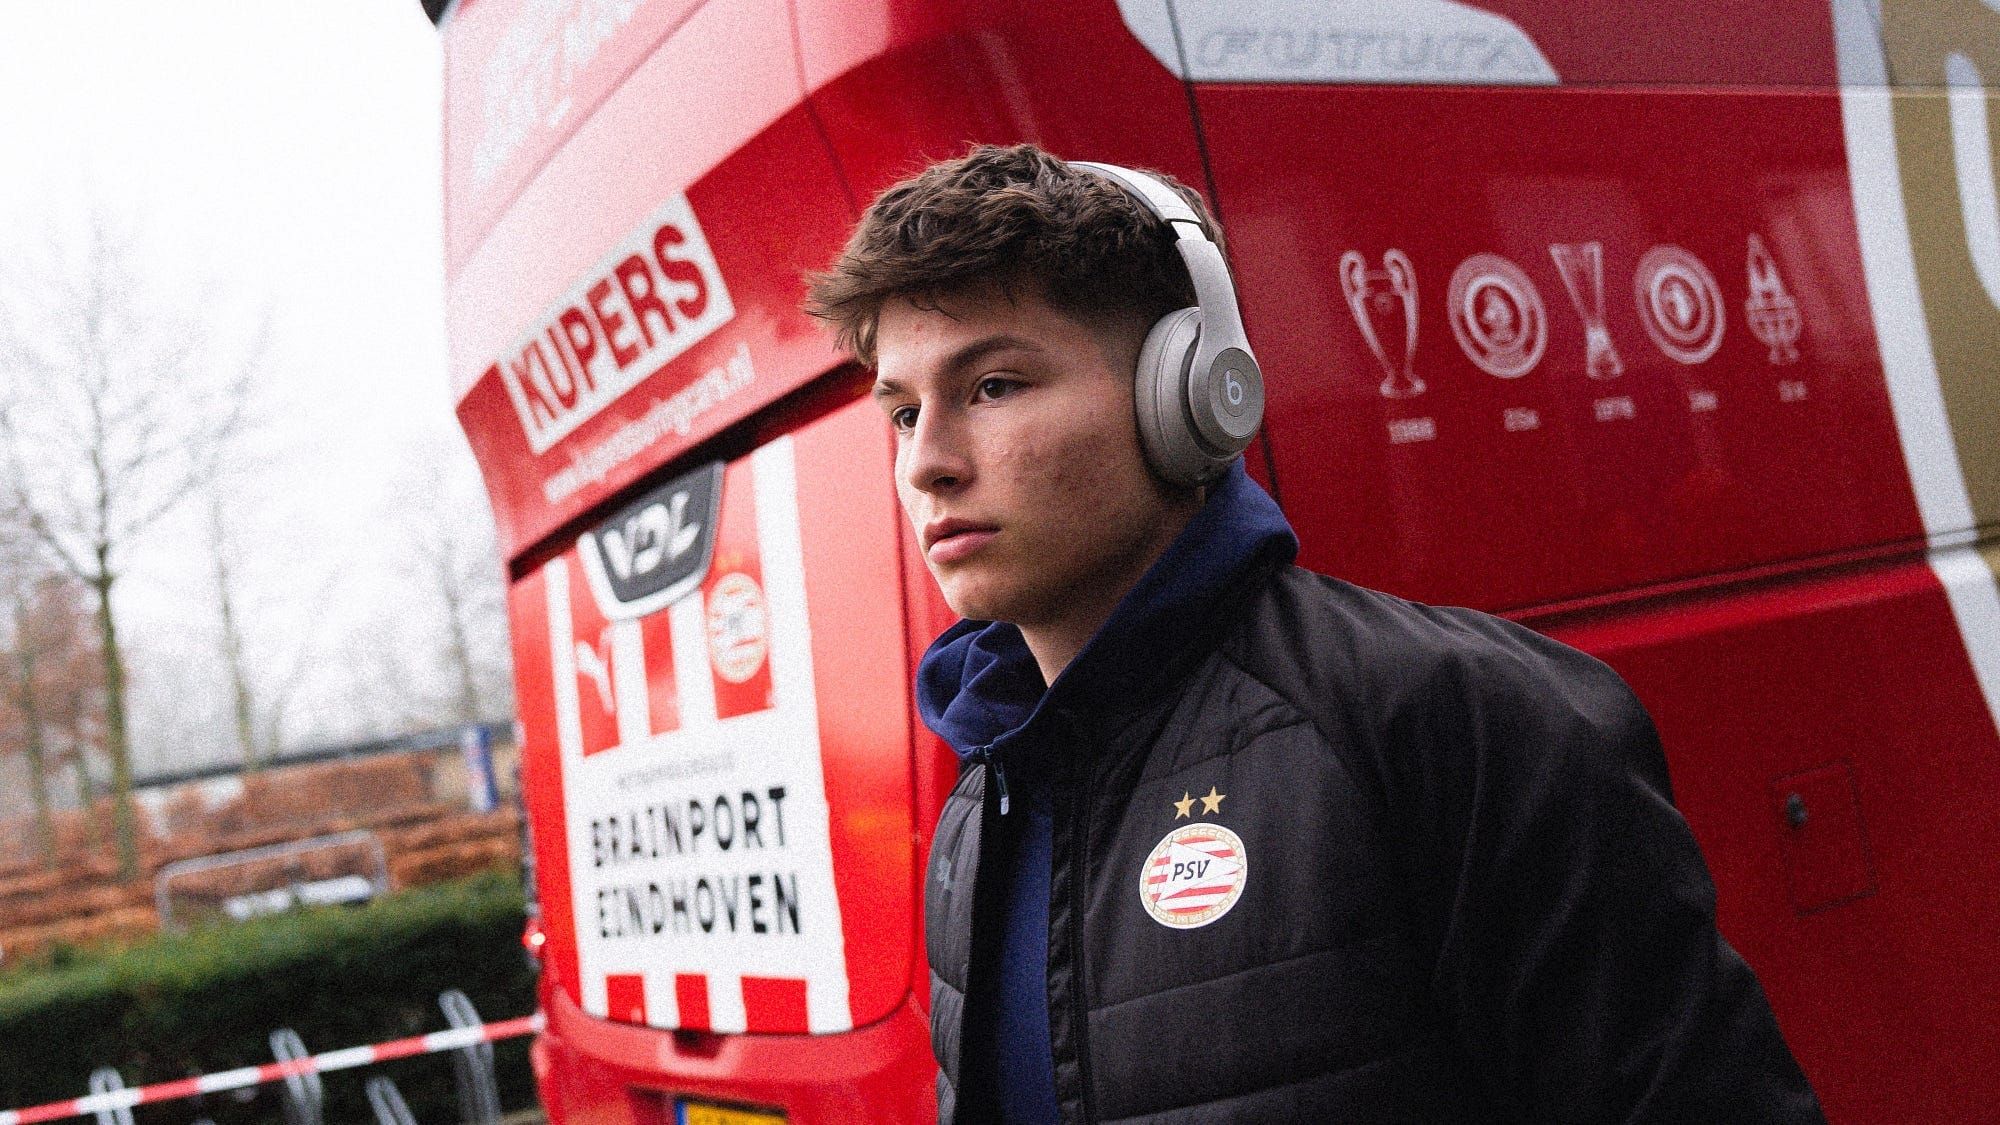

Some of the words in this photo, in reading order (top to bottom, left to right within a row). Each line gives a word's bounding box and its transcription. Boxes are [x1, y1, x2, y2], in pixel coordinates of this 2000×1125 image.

[511, 225, 708, 430] KUPERS
[604, 492, 700, 579] VDL
[592, 787, 785, 868] BRAINPORT
[599, 874, 800, 938] EINDHOVEN
[1172, 859, 1210, 881] PSV
